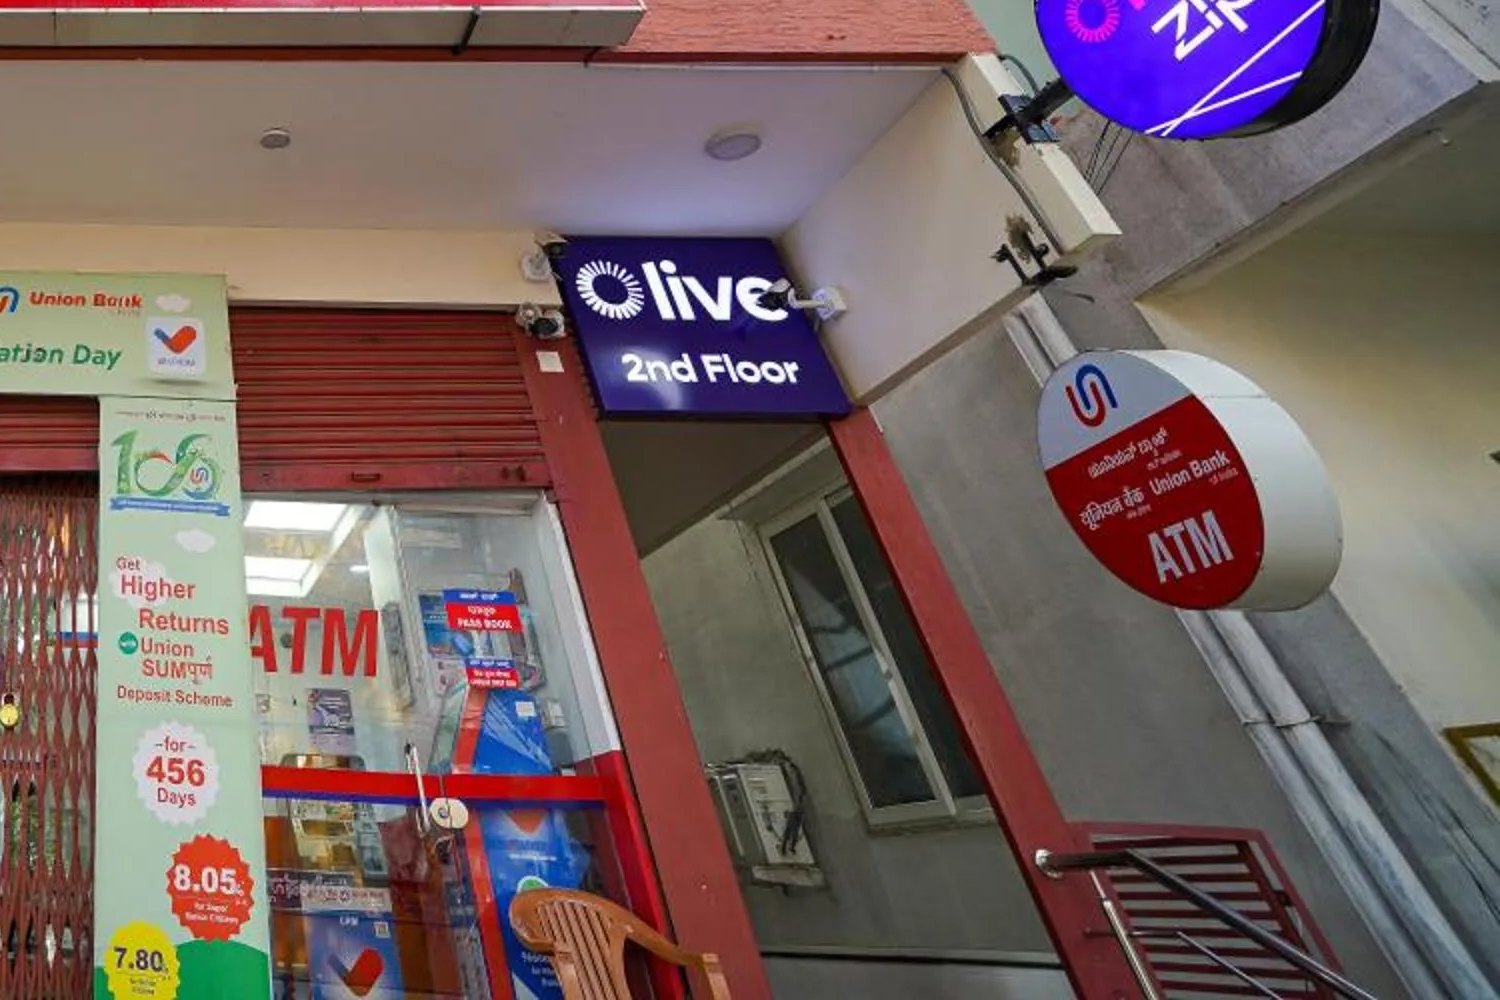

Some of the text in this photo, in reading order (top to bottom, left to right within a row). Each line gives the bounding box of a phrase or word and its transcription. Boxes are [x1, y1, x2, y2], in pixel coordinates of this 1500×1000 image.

[29, 290, 144, 309] Union Bank
[72, 342, 122, 371] Day
[621, 352, 799, 384] 2nd Floor
[1149, 467, 1192, 496] Union
[1189, 449, 1231, 478] Bank
[1148, 509, 1234, 584] ATM
[116, 556, 141, 572] Get
[121, 574, 197, 601] Higher
[139, 607, 230, 635] Returns
[140, 637, 194, 657] Union
[248, 604, 378, 678] ATM
[116, 684, 233, 709] Deposit Scheme
[145, 755, 206, 788] 456
[156, 787, 198, 809] Days
